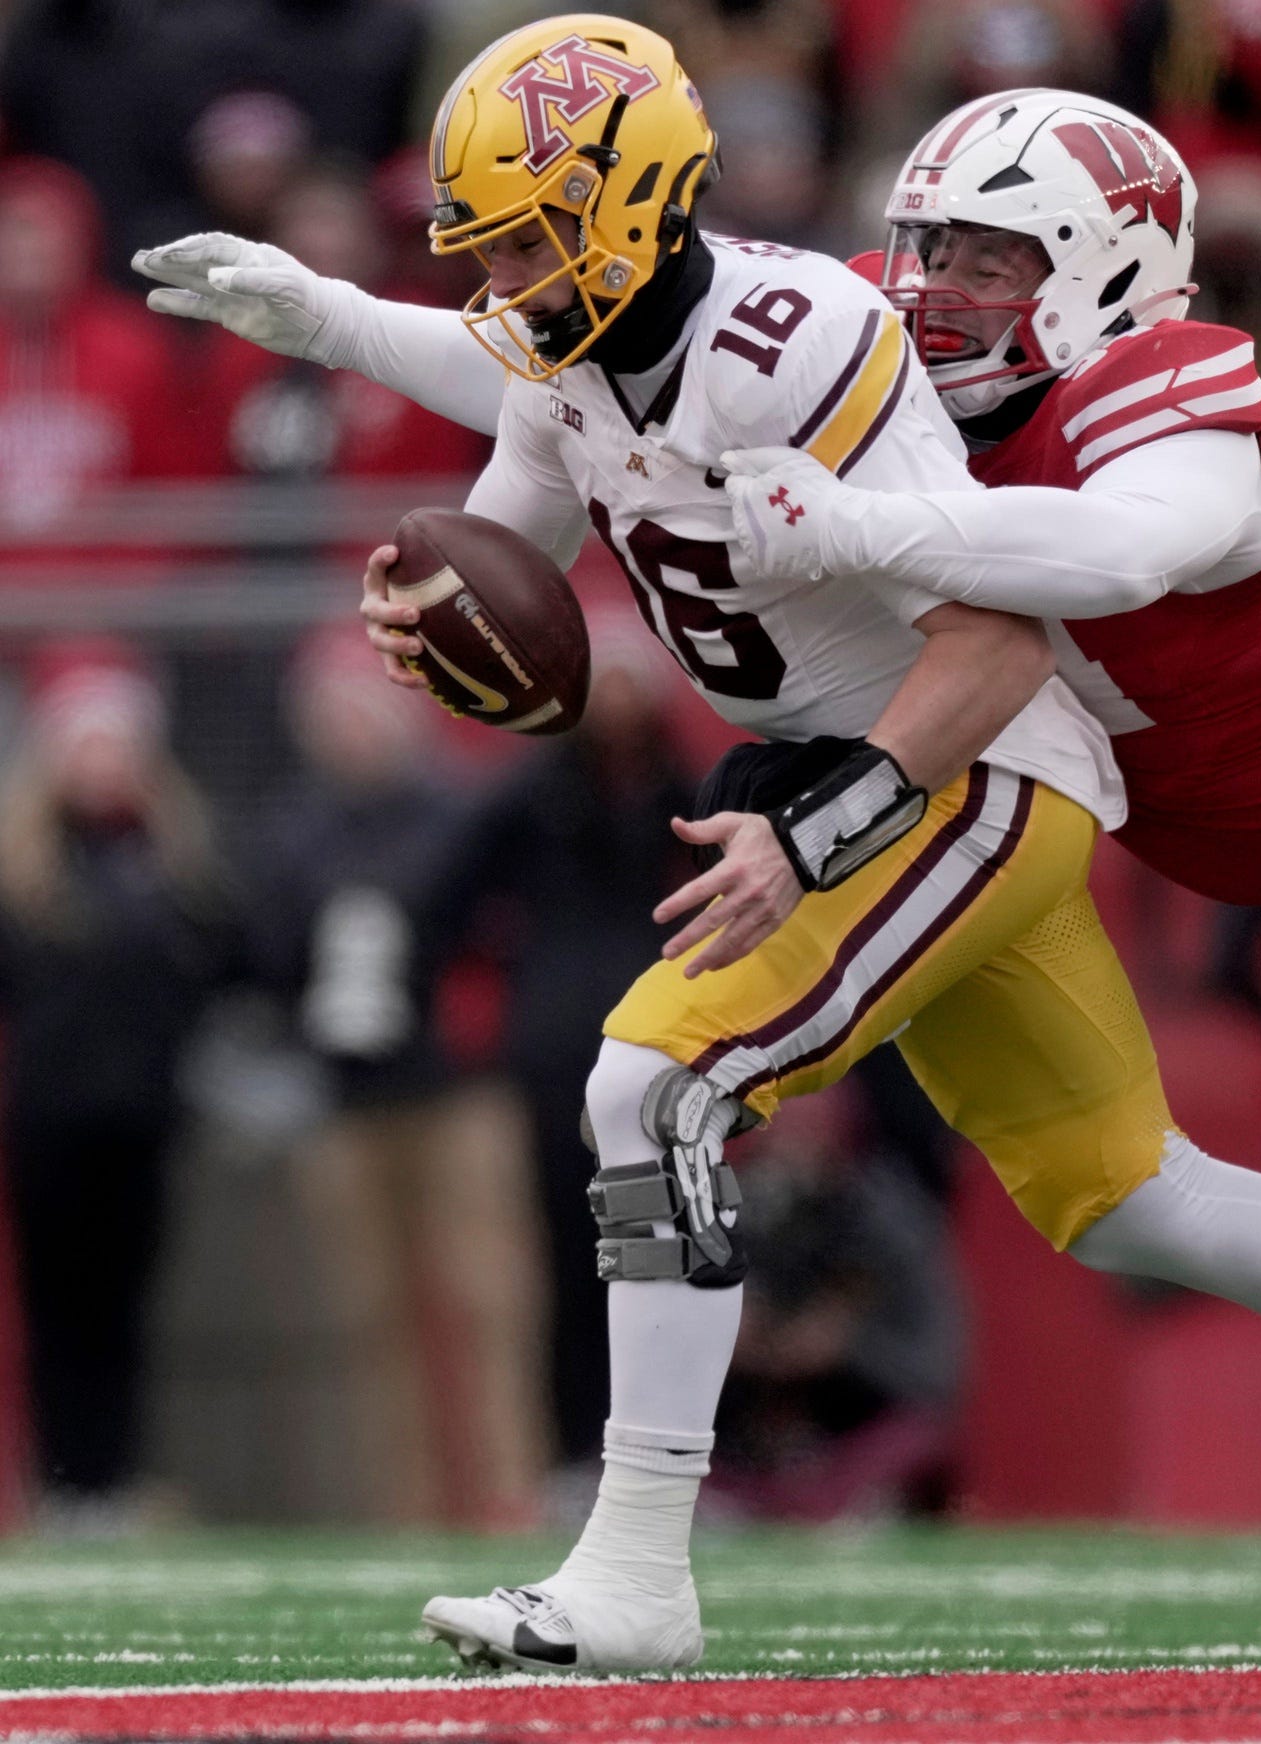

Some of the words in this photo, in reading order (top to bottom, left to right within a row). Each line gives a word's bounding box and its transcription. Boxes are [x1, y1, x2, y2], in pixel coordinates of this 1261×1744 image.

[498, 33, 662, 177] M
[1050, 122, 1182, 248] W
[710, 282, 812, 378] 16
[588, 496, 787, 700] 16
